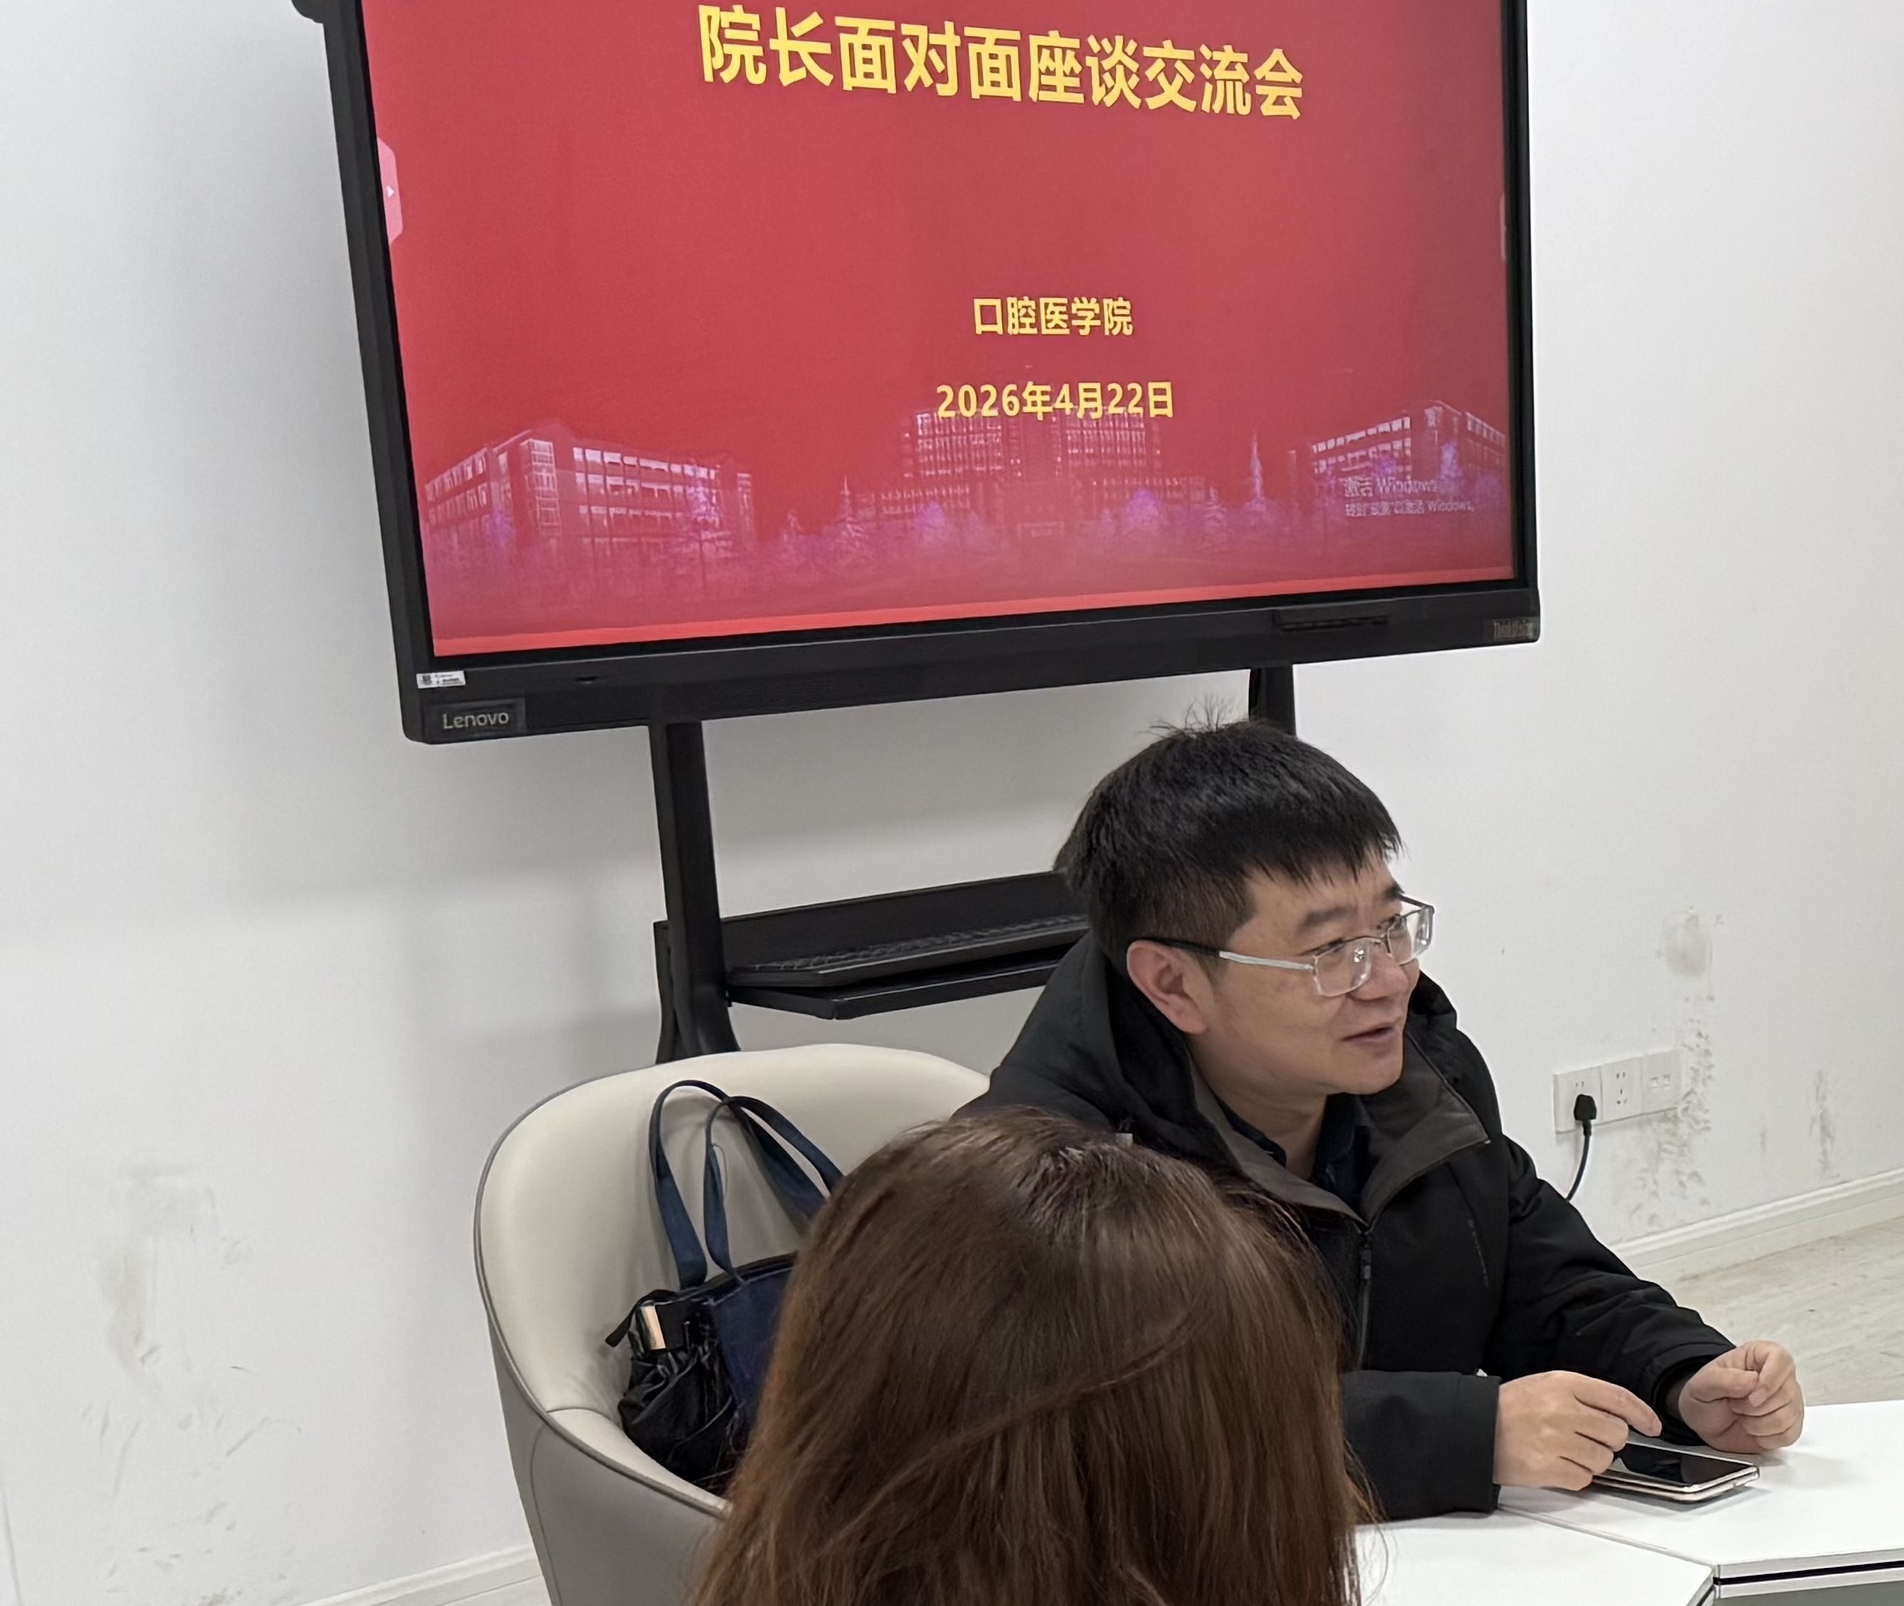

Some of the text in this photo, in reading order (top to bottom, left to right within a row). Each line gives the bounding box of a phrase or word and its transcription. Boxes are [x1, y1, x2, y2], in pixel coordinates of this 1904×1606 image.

[698, 4, 1304, 120] 院长面对面座谈交流会
[973, 295, 1134, 336] 口腔医学院
[936, 380, 1174, 421] 2026年4月22日
[443, 712, 509, 729] Lenovo
